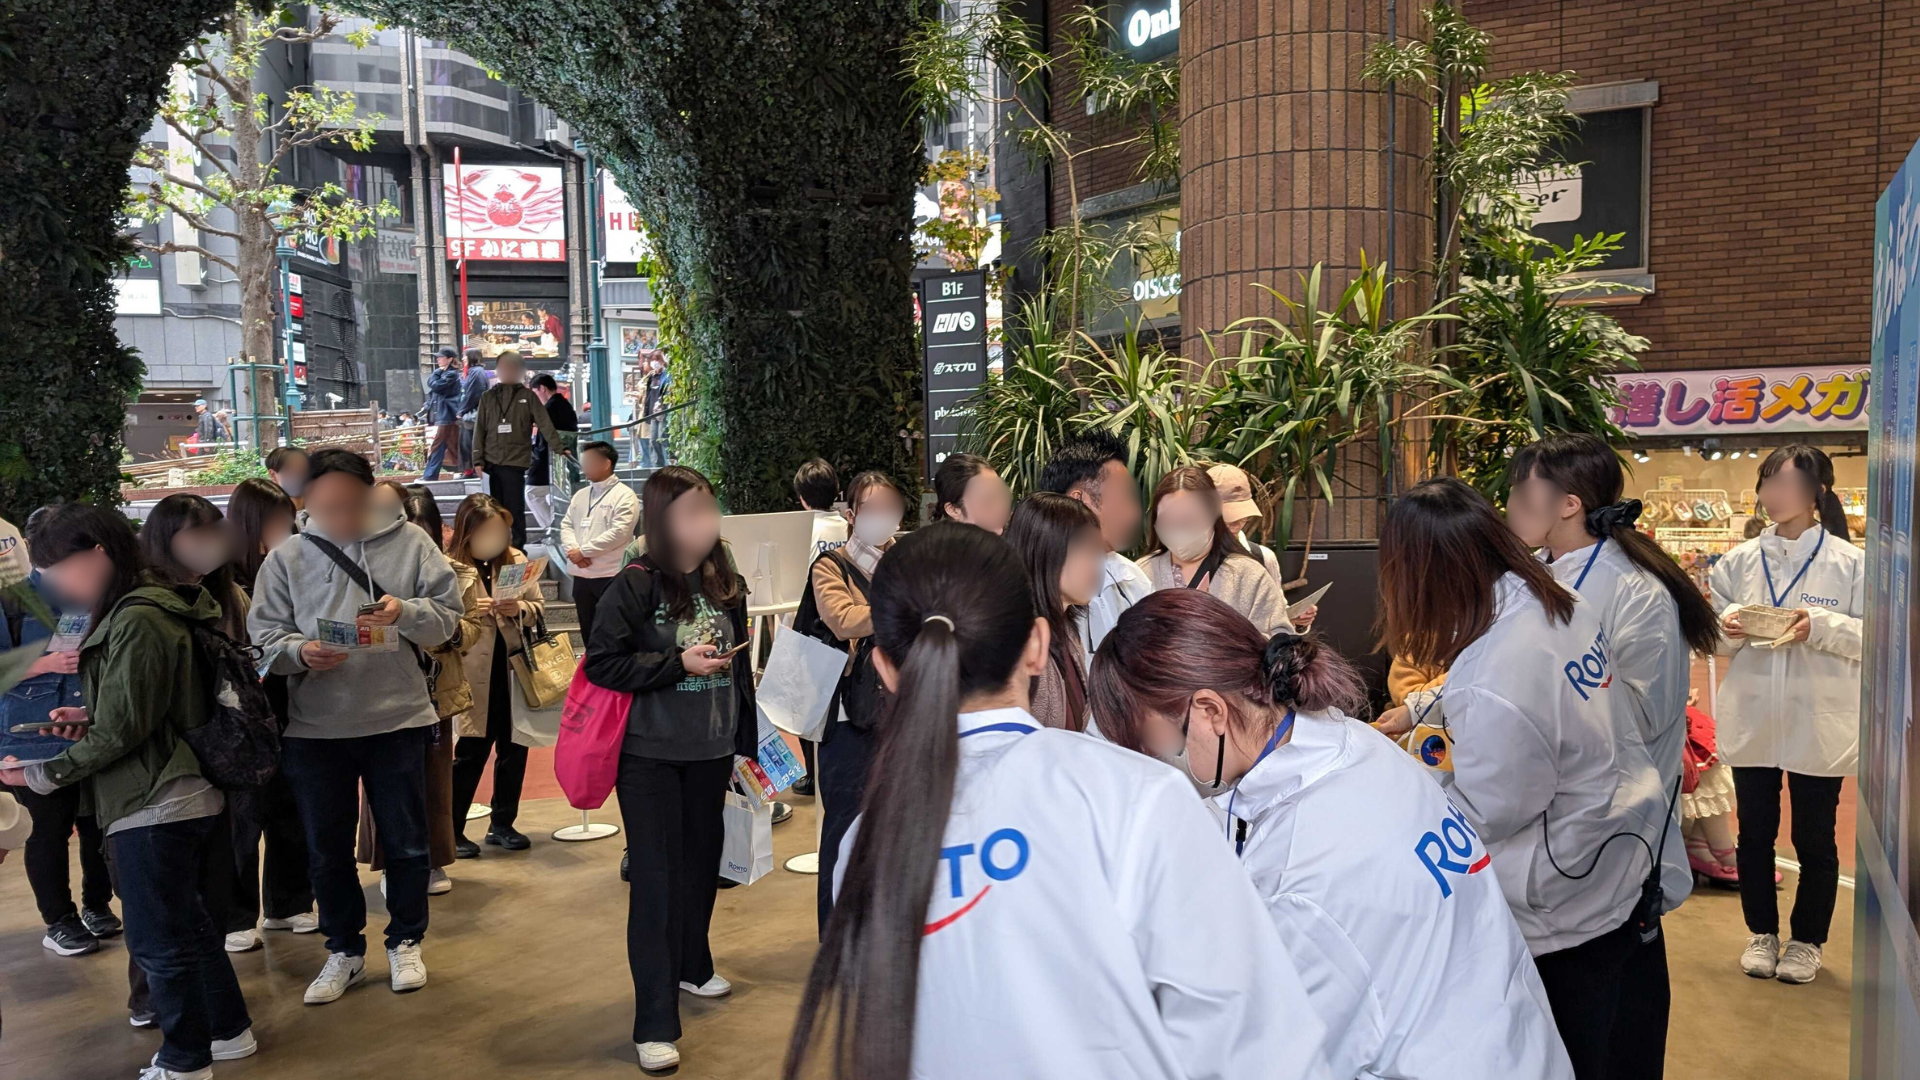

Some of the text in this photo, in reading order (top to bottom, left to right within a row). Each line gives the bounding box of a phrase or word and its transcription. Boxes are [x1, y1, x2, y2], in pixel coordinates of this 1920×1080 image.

[942, 281, 963, 296] B1F
[467, 304, 484, 316] 8F
[932, 311, 975, 333] HIS
[1800, 593, 1839, 606] ROHTO
[1414, 790, 1477, 899] ROH
[728, 861, 748, 873] ROHTO
